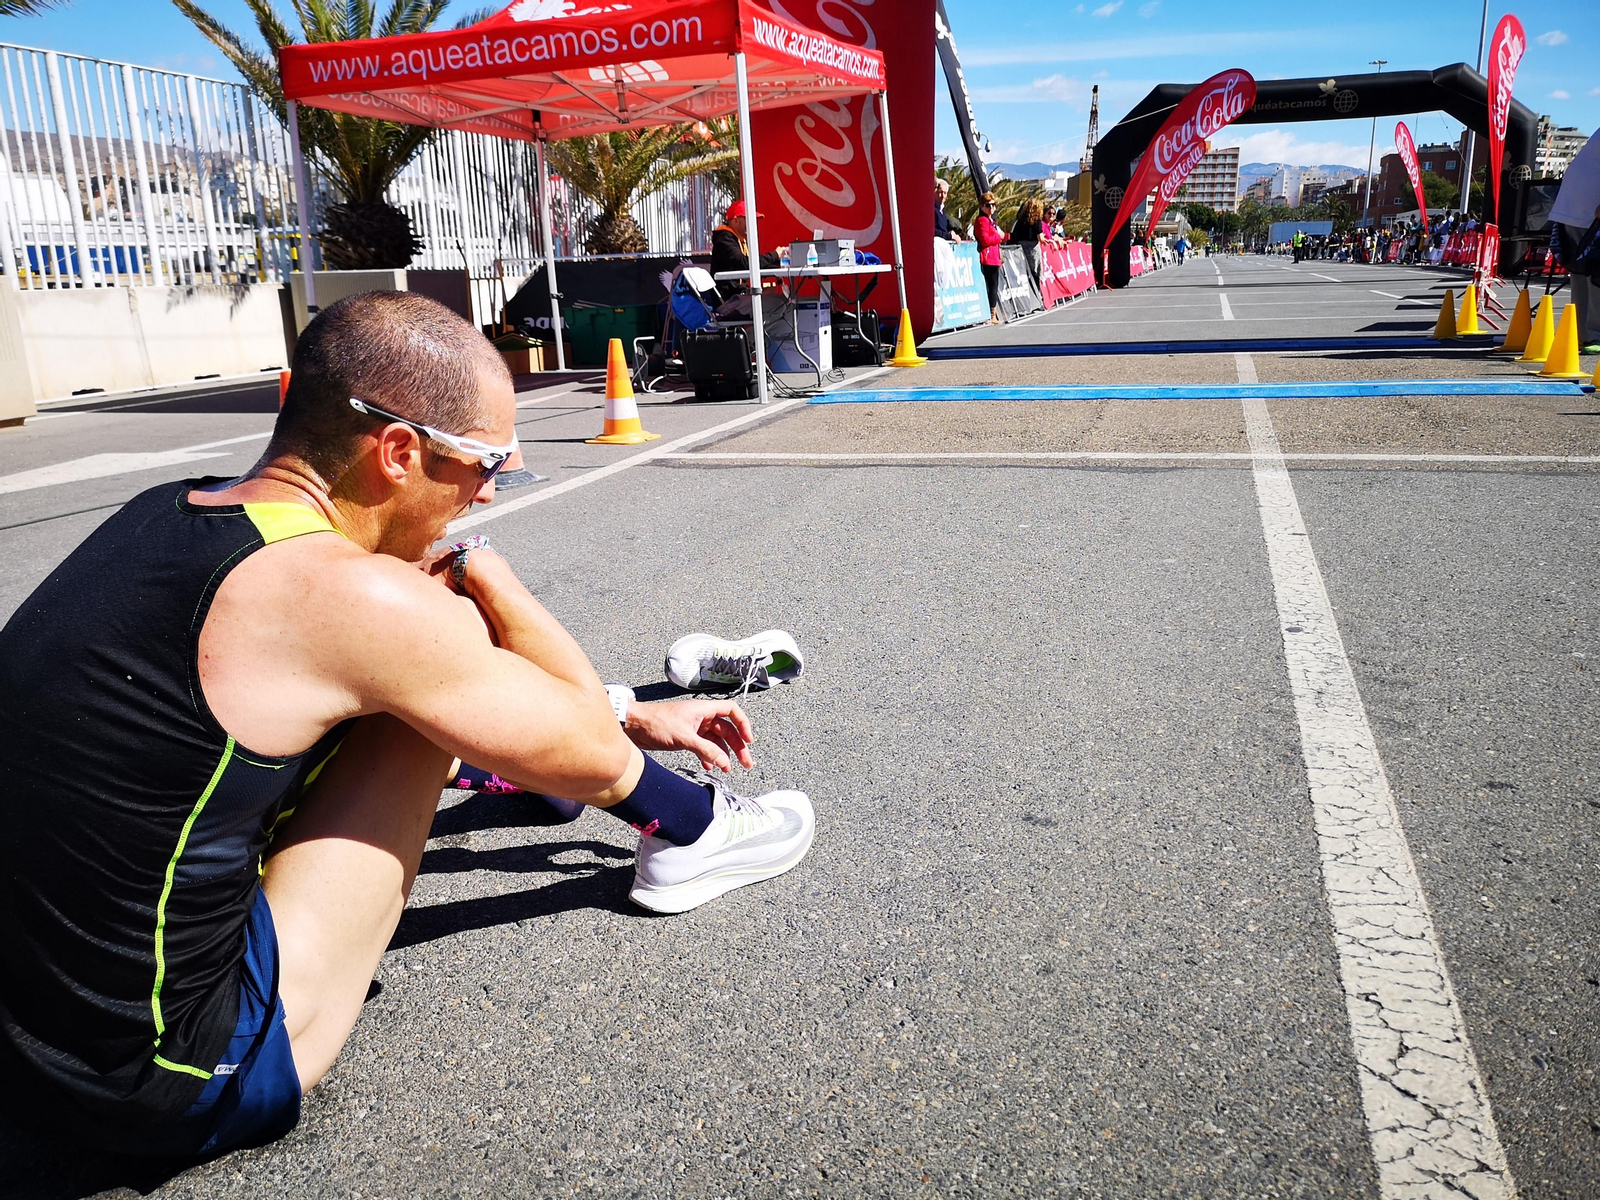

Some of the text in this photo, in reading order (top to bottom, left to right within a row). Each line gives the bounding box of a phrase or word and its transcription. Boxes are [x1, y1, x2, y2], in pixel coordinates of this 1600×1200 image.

[308, 15, 702, 83] www.aqueatacamos.com
[753, 17, 880, 80] www.aqueatacamos.com
[1154, 74, 1246, 175] Coca-Cola
[1250, 99, 1327, 113] quéatacamos
